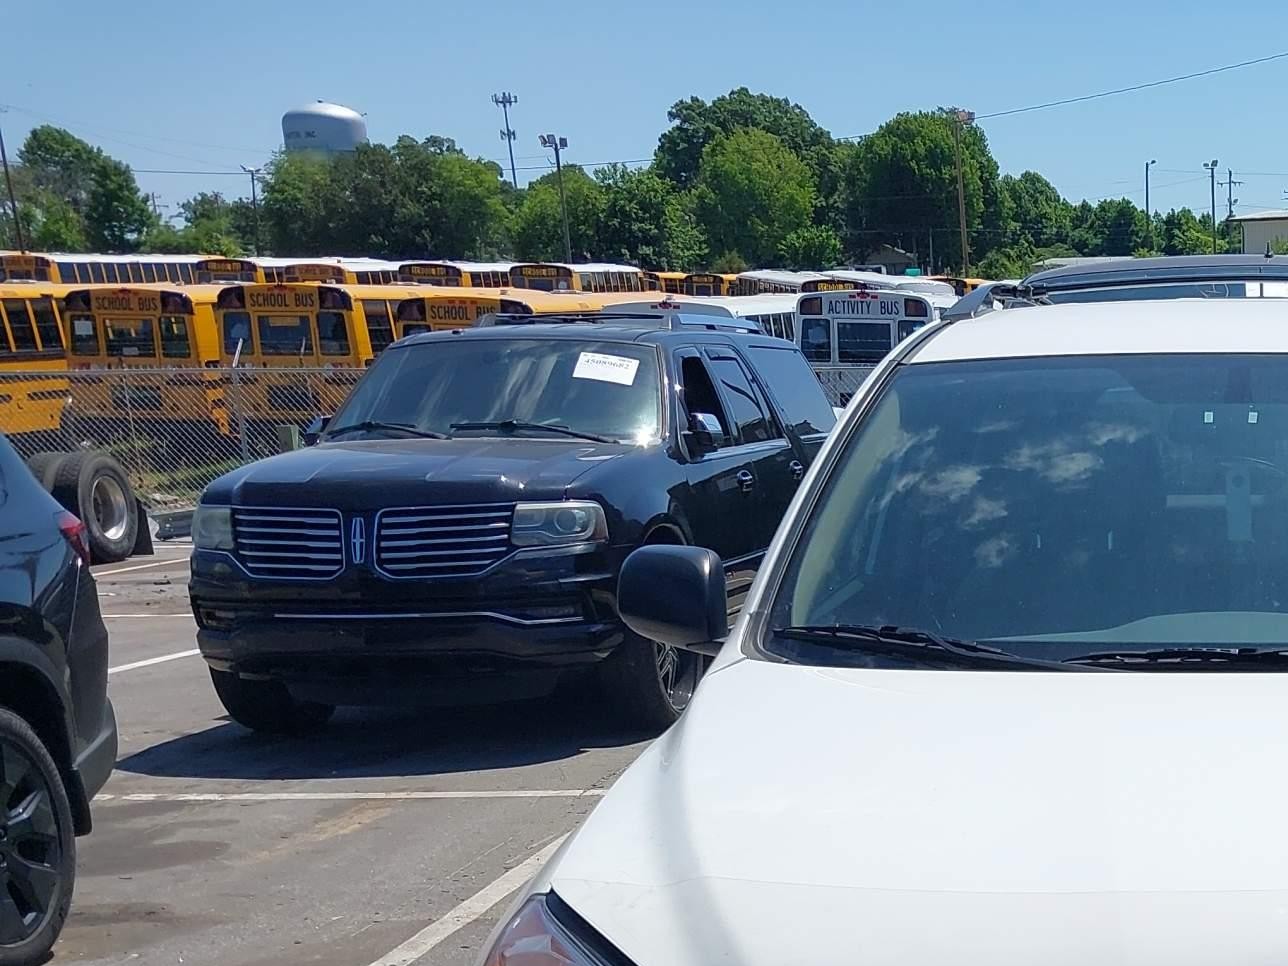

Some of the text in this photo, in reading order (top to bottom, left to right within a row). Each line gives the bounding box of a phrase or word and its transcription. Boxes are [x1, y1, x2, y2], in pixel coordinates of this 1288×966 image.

[95, 297, 157, 311] SCHOOL BUS
[250, 292, 314, 307] SCHOOL BUS
[430, 305, 471, 320] SCHOOL
[828, 300, 899, 315] ACTIVITY BUS
